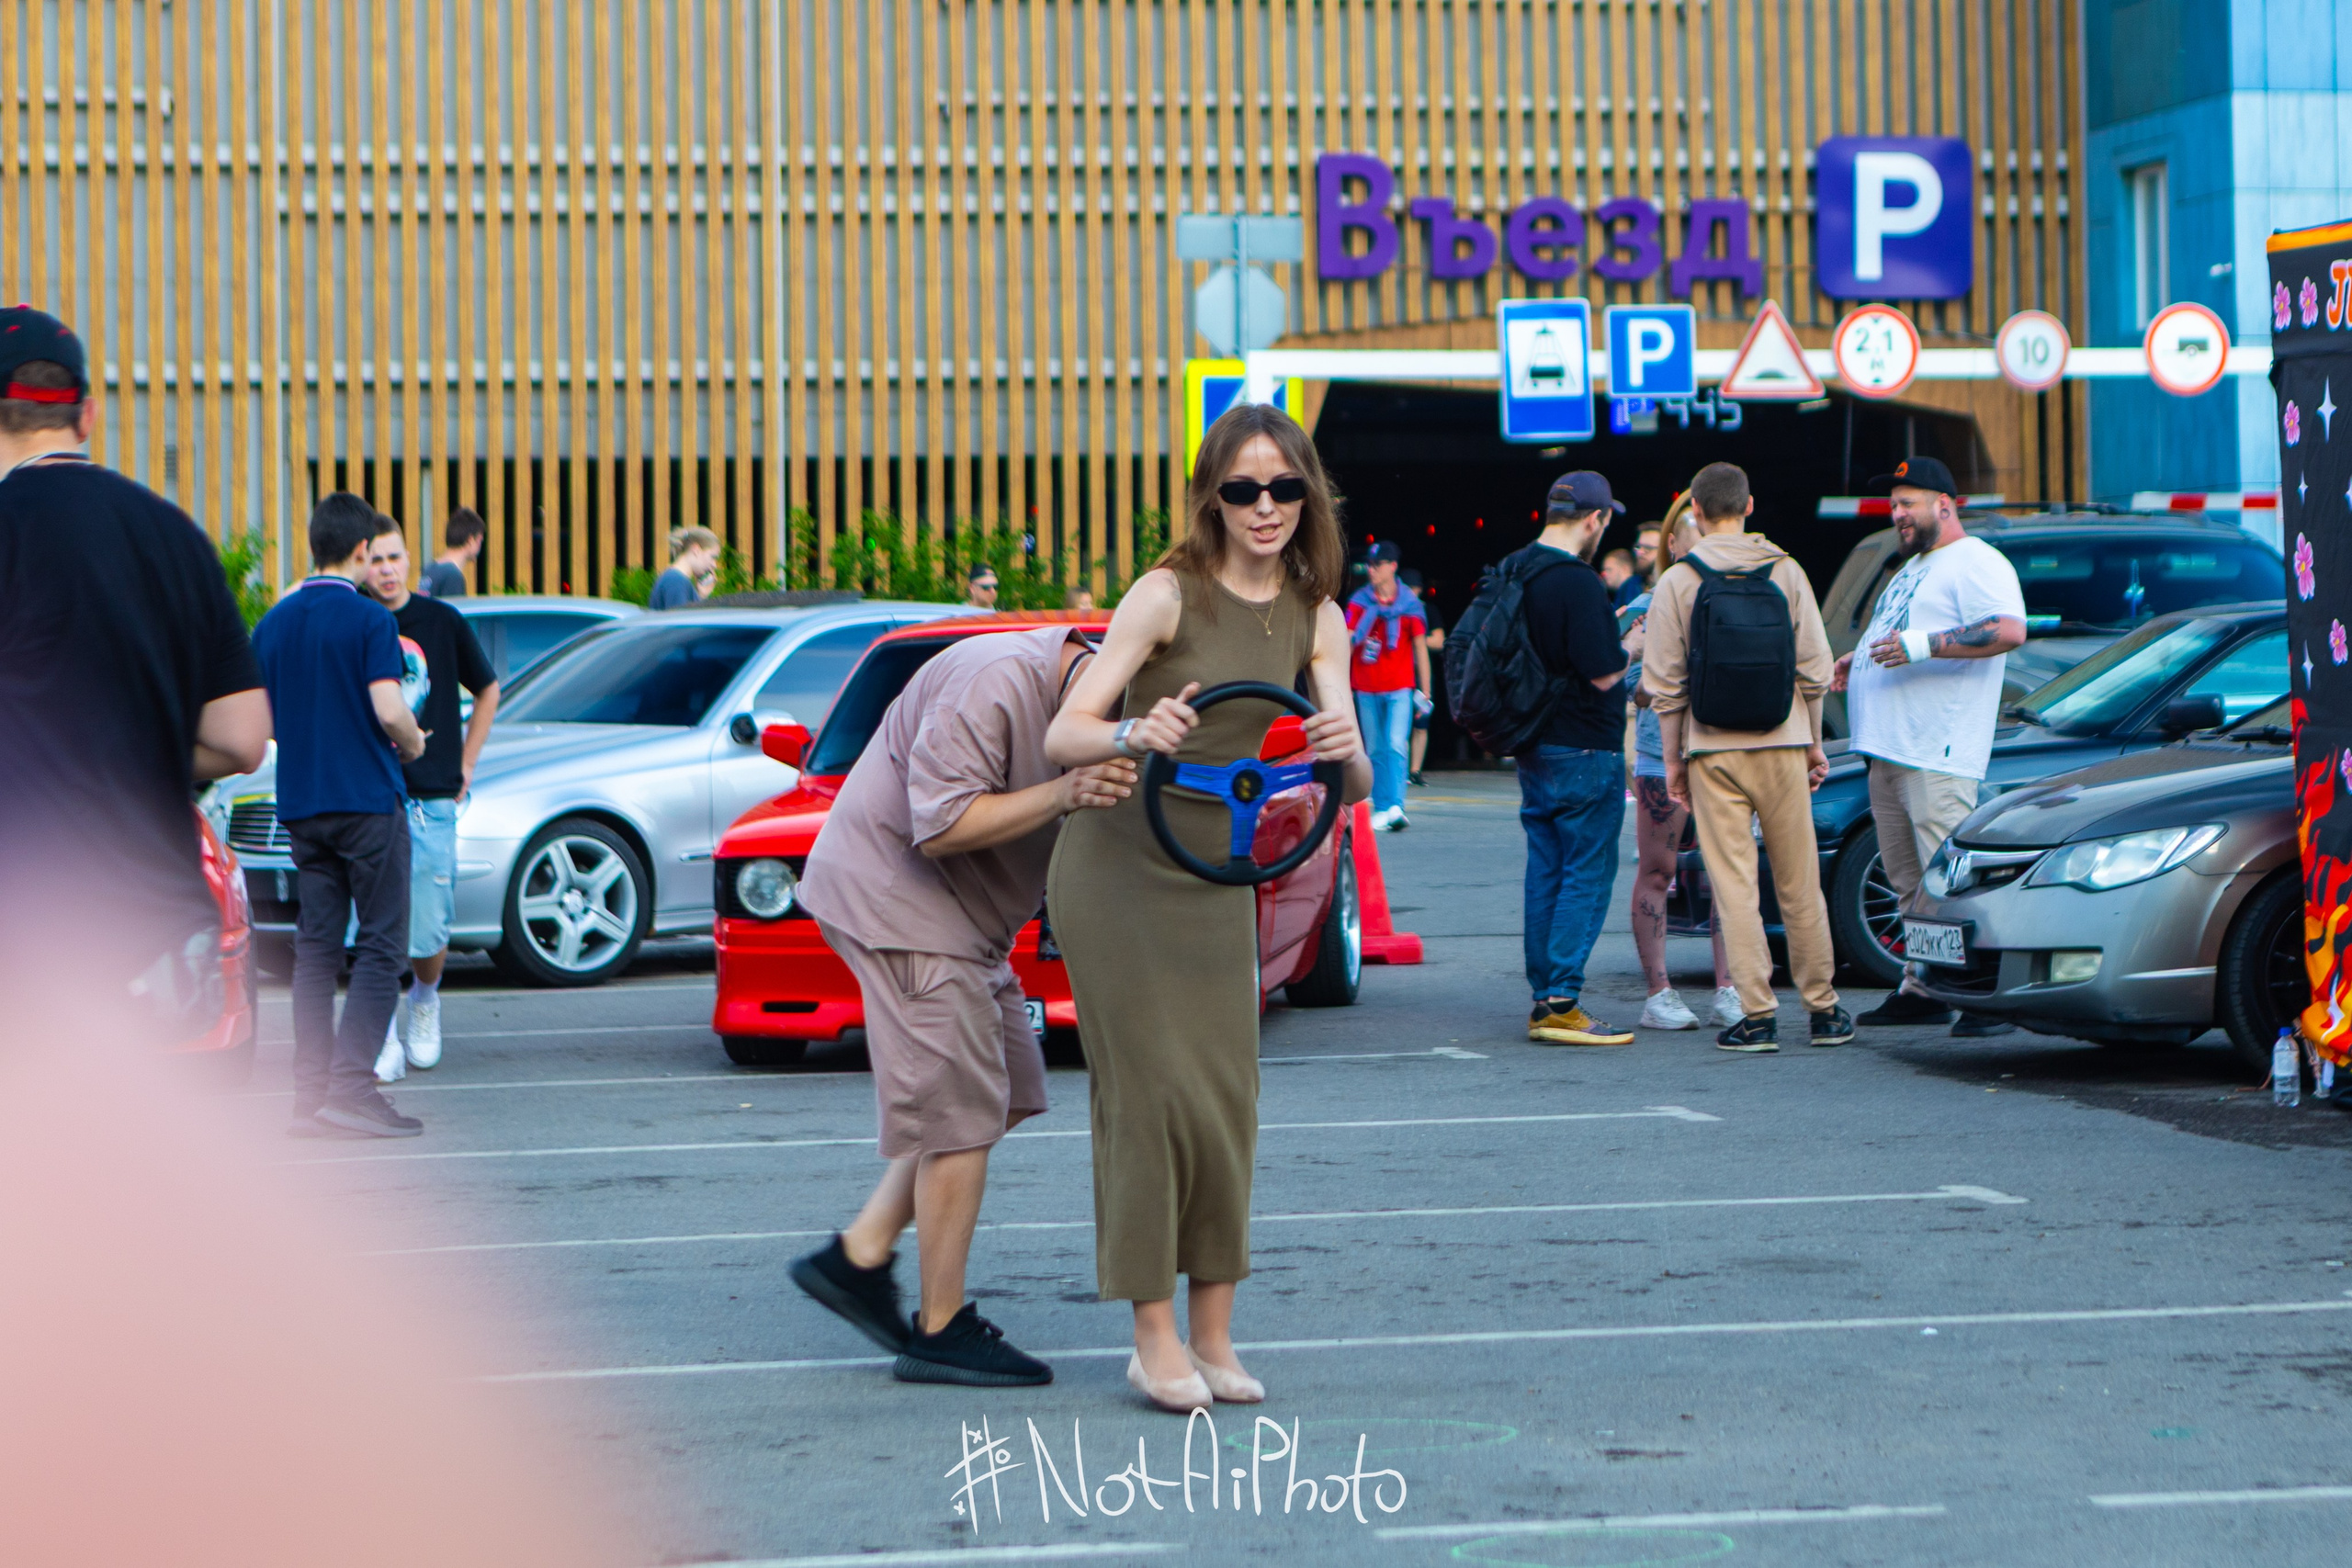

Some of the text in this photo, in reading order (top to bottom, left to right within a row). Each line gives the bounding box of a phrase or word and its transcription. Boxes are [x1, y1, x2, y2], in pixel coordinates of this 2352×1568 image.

[1317, 152, 1763, 298] Въезд
[1854, 151, 1943, 282] P
[1627, 317, 1675, 388] P
[2019, 336, 2050, 366] 10
